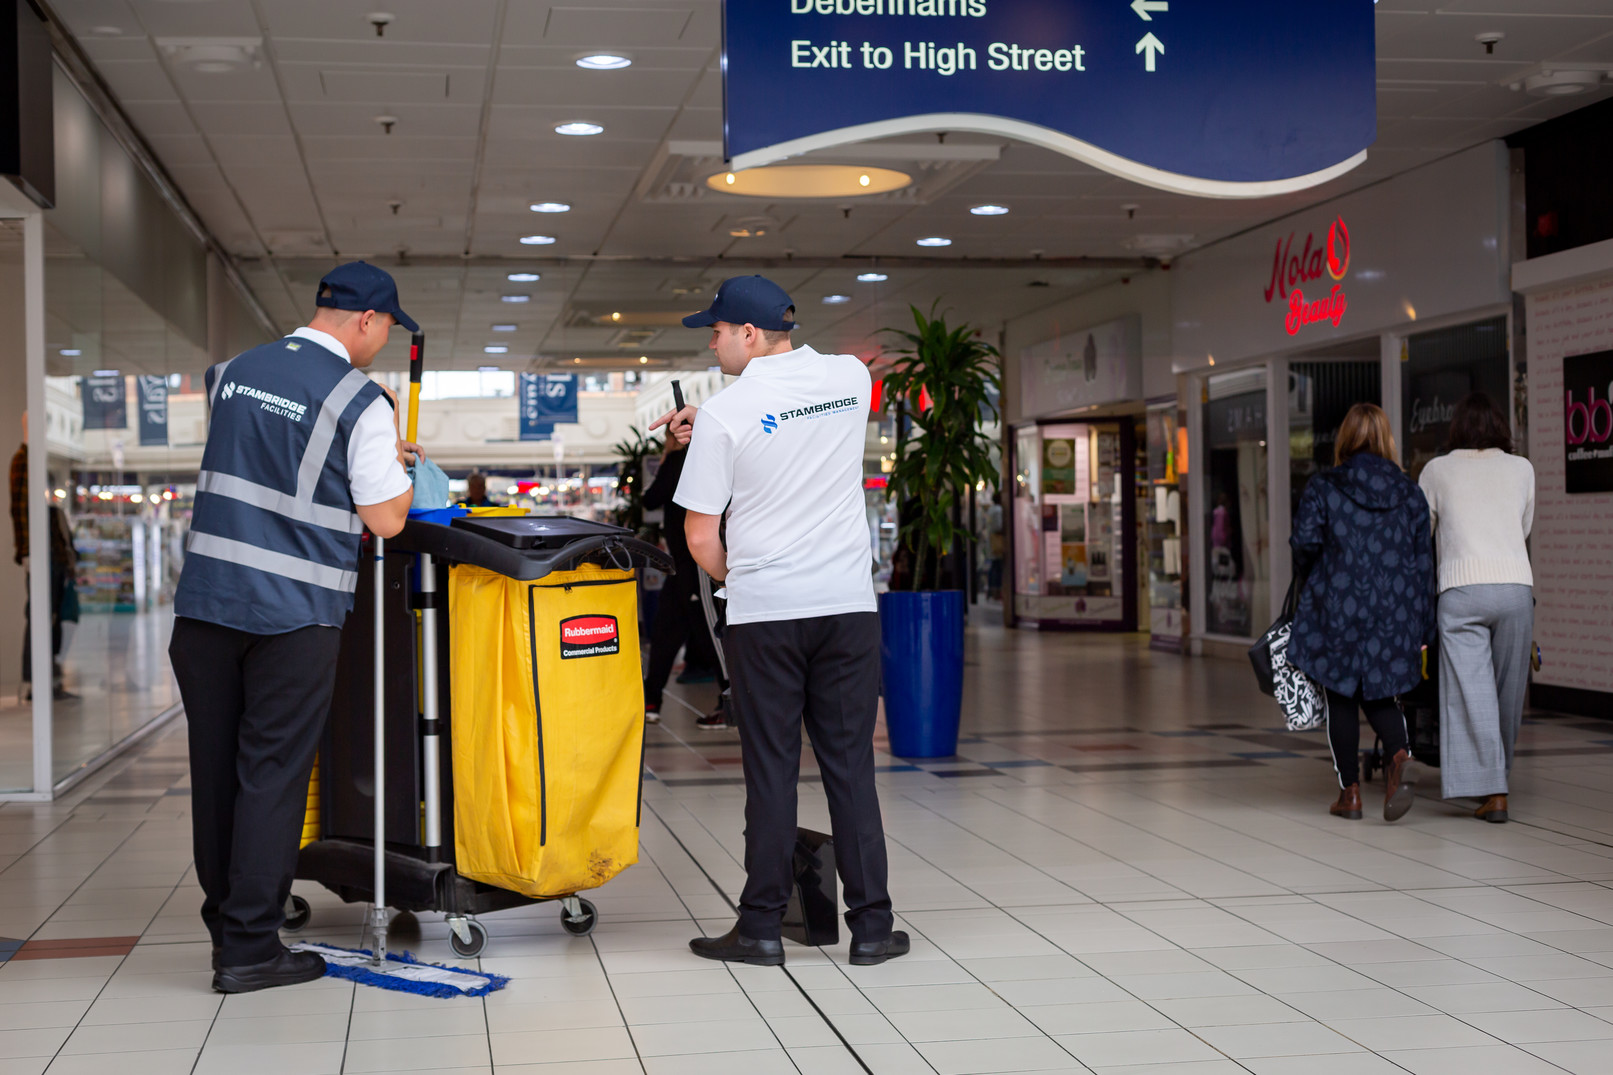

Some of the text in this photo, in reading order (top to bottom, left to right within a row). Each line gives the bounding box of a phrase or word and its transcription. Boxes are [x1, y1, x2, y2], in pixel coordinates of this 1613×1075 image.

[791, 40, 1086, 76] Exit to High Street
[1285, 283, 1348, 336] Beauty
[236, 384, 307, 415] STAMBRIDGE
[260, 402, 302, 422] FACILITIES
[780, 396, 858, 421] STAMBRIDGE
[564, 624, 614, 637] Rubbermaid
[563, 645, 617, 657] Commercial Products
